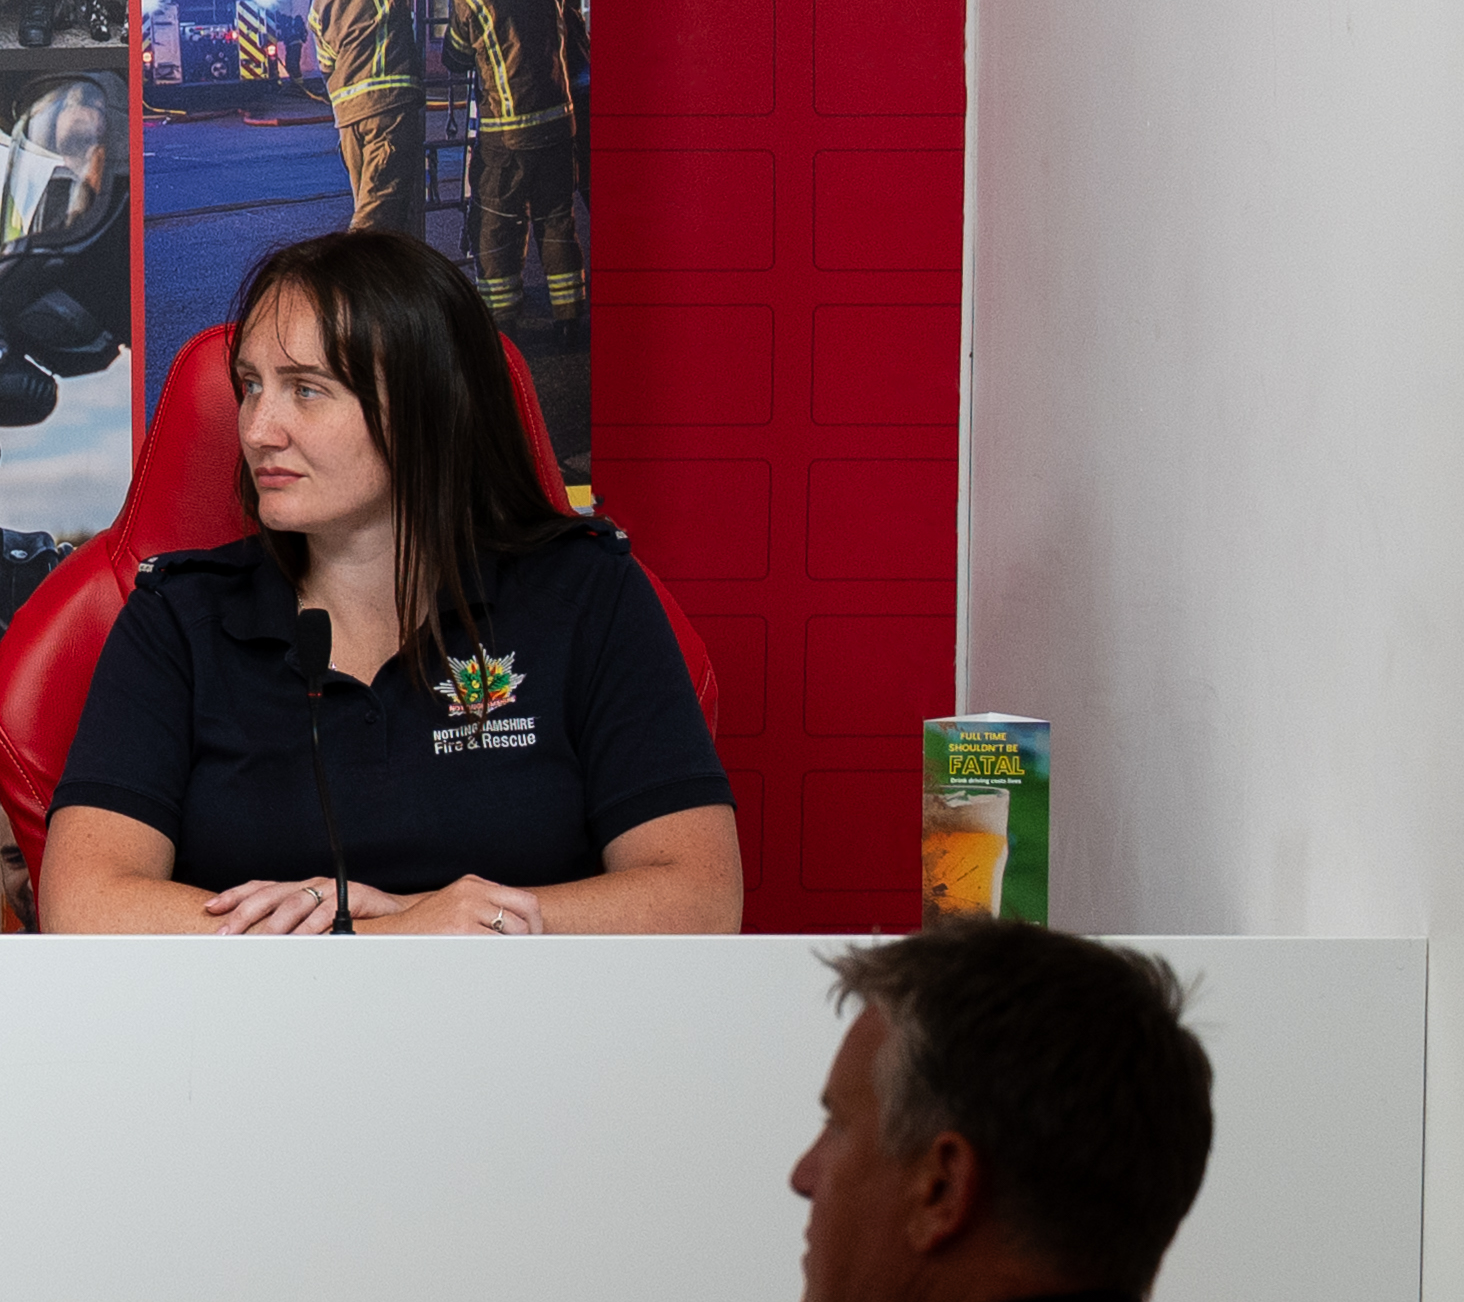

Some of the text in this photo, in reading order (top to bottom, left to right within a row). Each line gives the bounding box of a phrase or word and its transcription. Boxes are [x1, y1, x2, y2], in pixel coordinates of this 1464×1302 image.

[960, 732, 1006, 740] FULL TIME
[434, 732, 536, 755] Fire & Rescue
[949, 743, 1018, 752] SHOULDN'T BE
[949, 755, 1025, 775] FATAL
